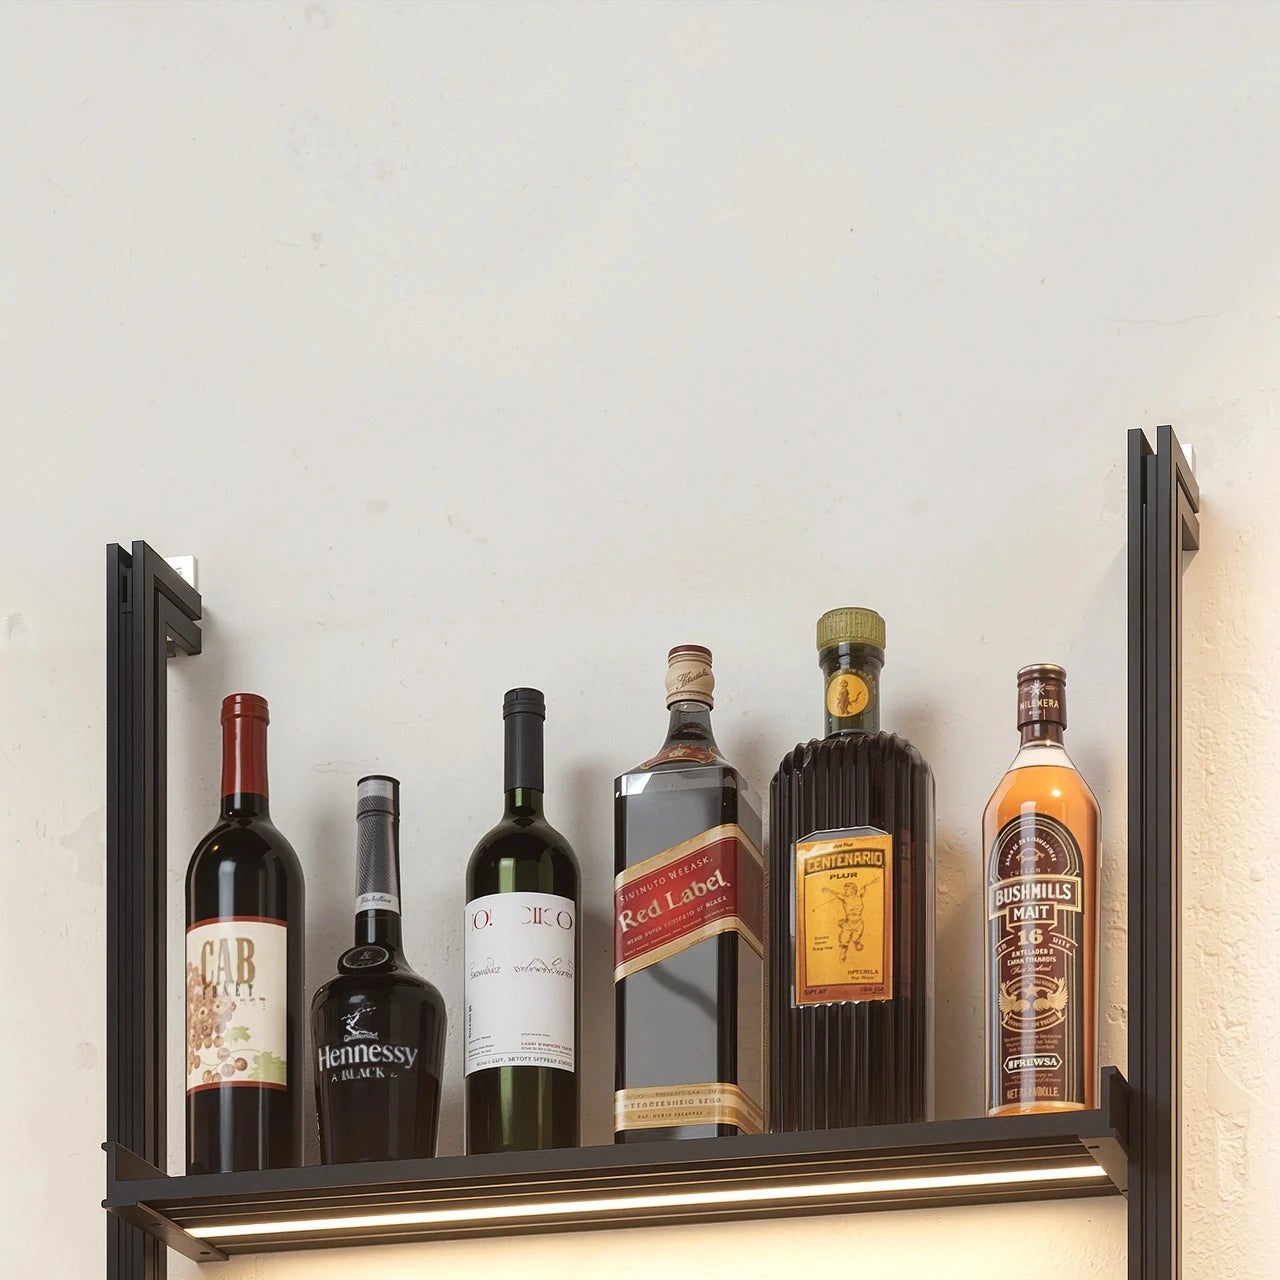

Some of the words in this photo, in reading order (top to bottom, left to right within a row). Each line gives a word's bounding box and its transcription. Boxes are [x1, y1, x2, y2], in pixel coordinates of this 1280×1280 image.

[996, 883, 1072, 907] BUSHMILLS
[618, 898, 663, 933] Red
[1018, 929, 1043, 945] 16
[201, 937, 256, 987] CAB
[319, 1042, 419, 1072] Hennessy
